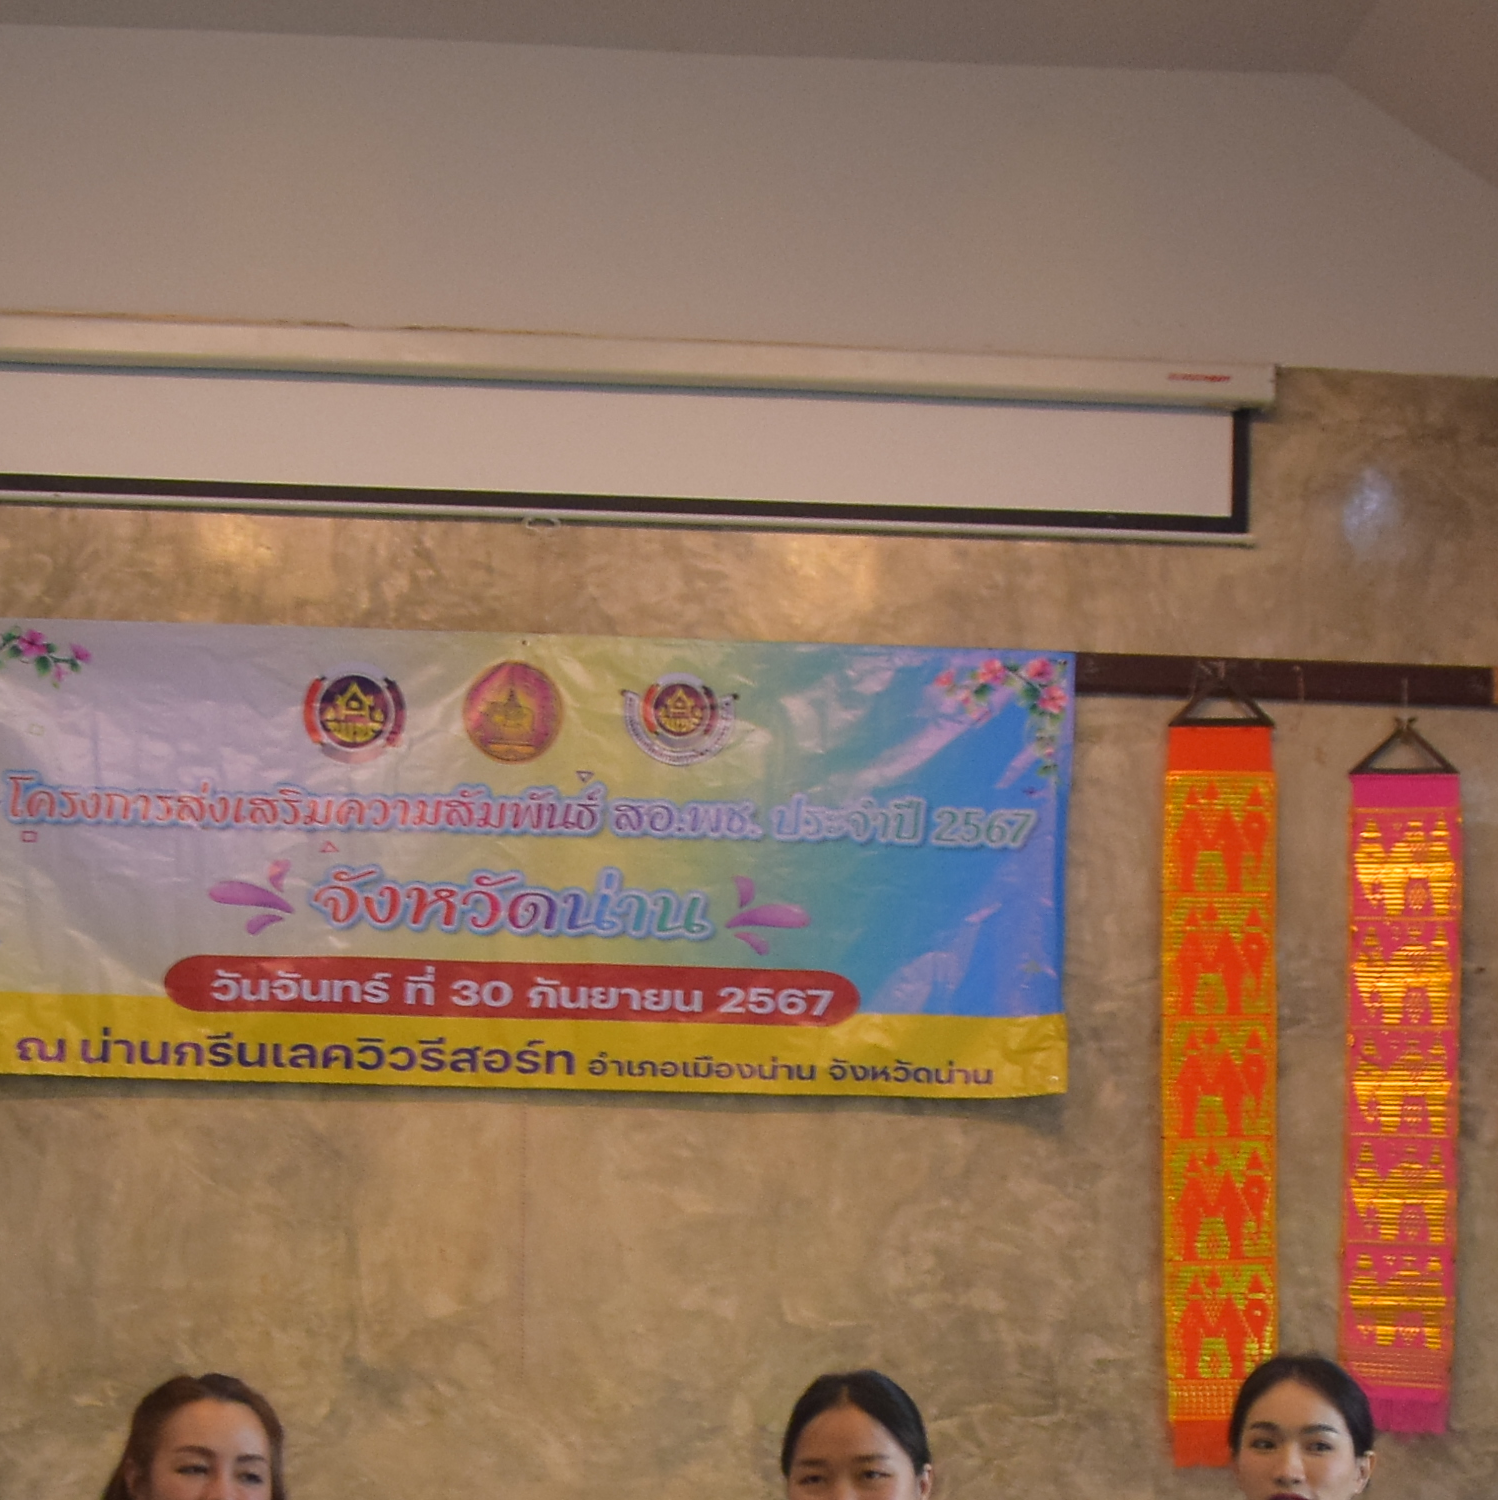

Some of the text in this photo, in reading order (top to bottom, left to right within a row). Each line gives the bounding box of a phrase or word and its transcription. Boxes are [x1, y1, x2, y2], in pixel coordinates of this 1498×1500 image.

[5, 774, 602, 832] โครงการส่งเสริมความสัมพันธ์
[773, 796, 925, 843] ประจำปี
[934, 809, 1034, 846] 2567
[312, 868, 707, 934] จังหวัดน่าน
[210, 965, 836, 1017] วันจันทร์ ที่ 30 กันยายน 2567
[14, 1026, 995, 1086] ณ น่านกรีนเลควิวรีสอร์ท อำเภอเมืองน่าน จังหวัดน่าน
